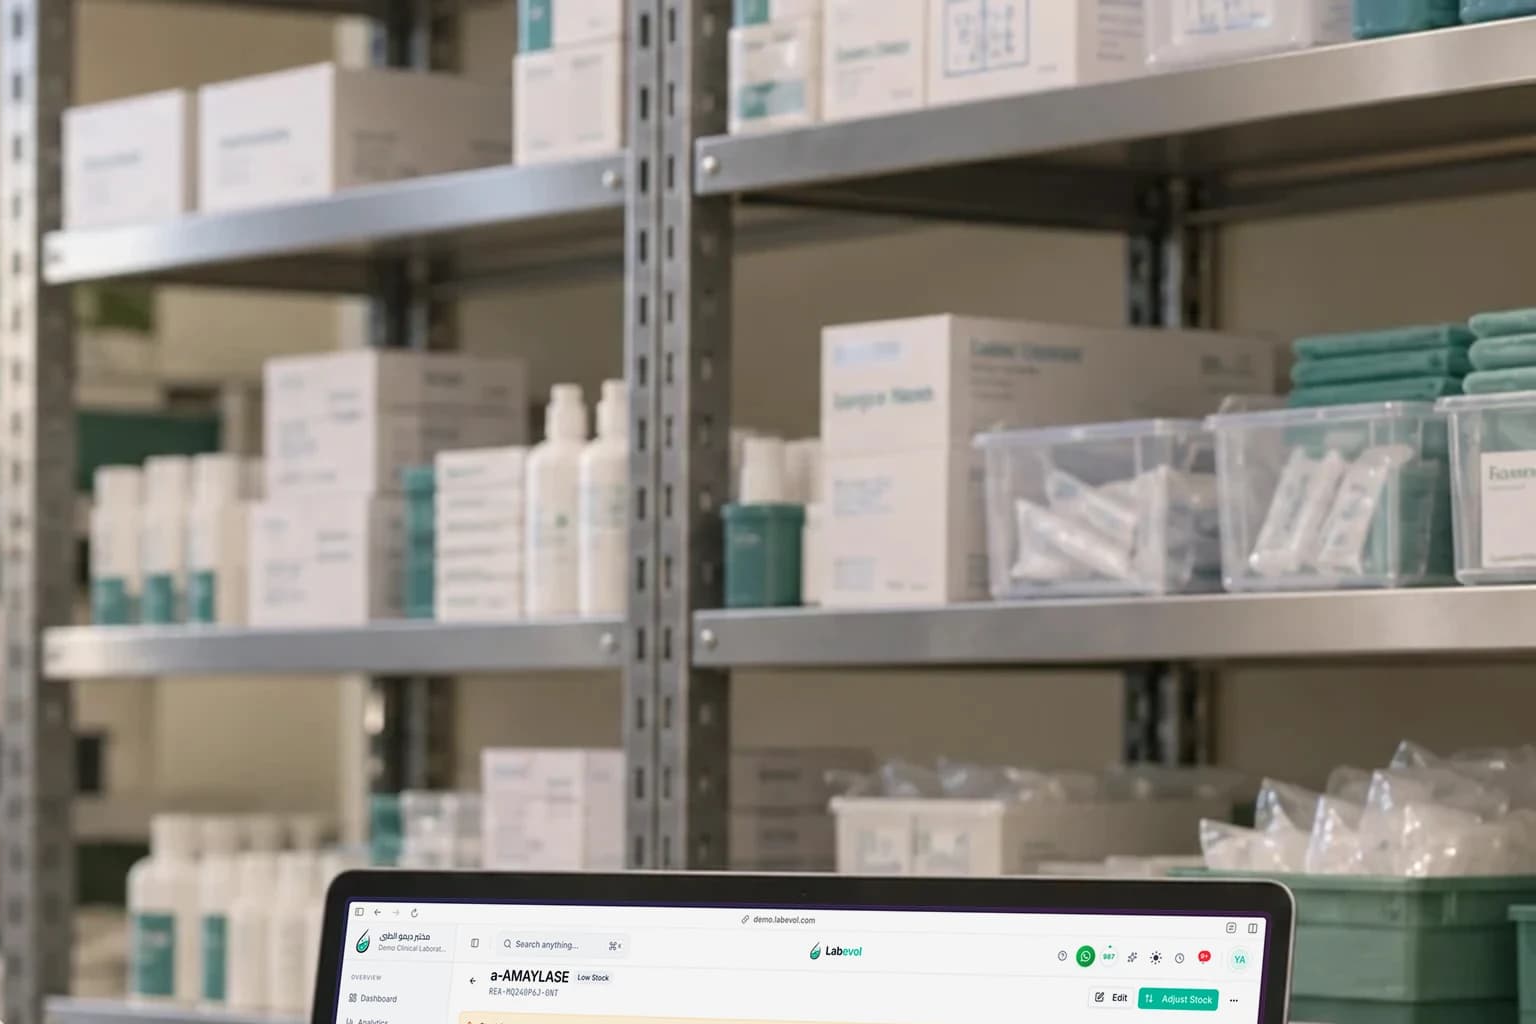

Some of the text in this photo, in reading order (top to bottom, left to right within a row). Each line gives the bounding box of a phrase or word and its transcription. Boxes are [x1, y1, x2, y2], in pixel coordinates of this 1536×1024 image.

[753, 915, 815, 924] demo.labevol.com
[515, 939, 578, 950] Search anything...
[825, 945, 862, 956] Labevol
[1234, 955, 1245, 964] YA
[489, 968, 570, 985] a-AMAYLASE
[577, 973, 609, 981] Low Stock
[360, 993, 397, 1003] Dashboard
[1111, 993, 1128, 1002] Edit
[1161, 995, 1212, 1004] Adjust Stock
